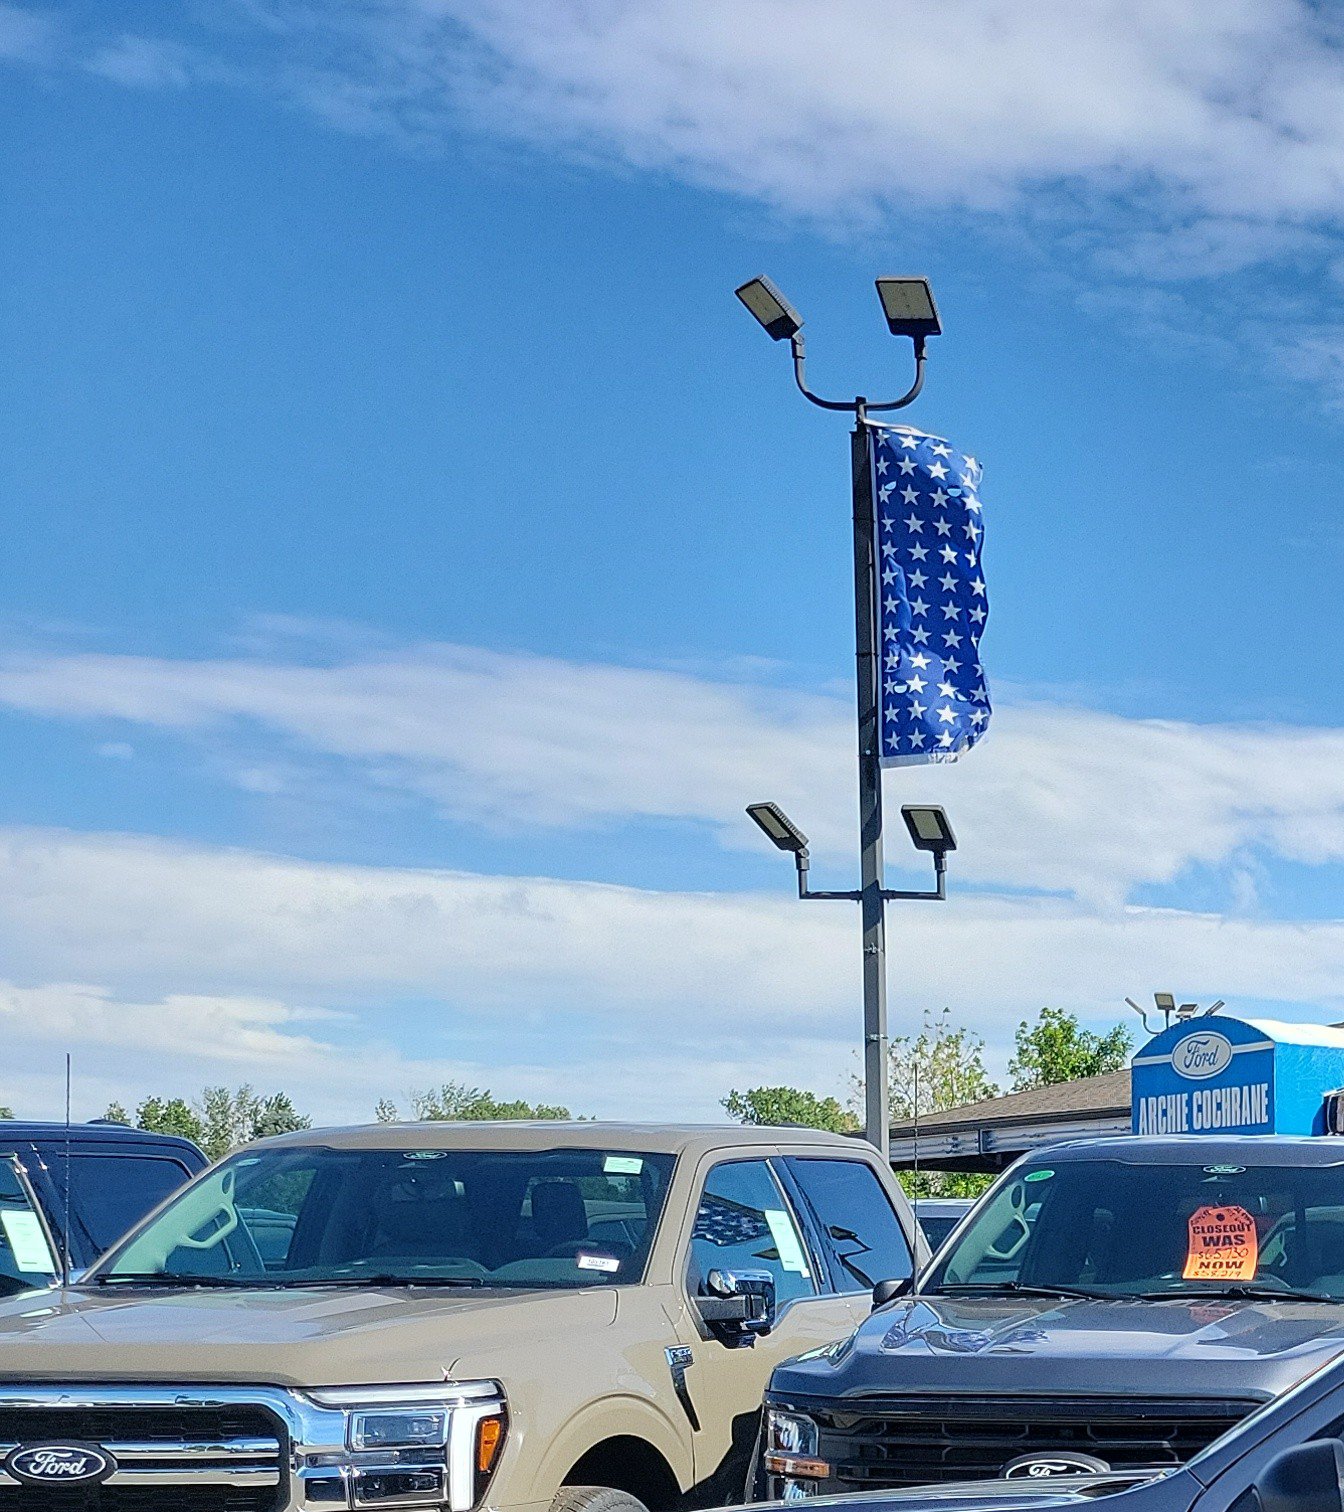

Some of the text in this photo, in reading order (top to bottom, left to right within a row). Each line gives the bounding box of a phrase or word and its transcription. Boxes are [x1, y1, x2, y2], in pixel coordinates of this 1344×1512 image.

[1183, 1039, 1220, 1069] Ford
[1138, 1082, 1269, 1135] ARCHIE COCHRANE
[1192, 1223, 1252, 1235] CLOSEOUT
[1202, 1234, 1246, 1247] WAS
[1198, 1260, 1245, 1269] NOW
[28, 1450, 87, 1475] Ford
